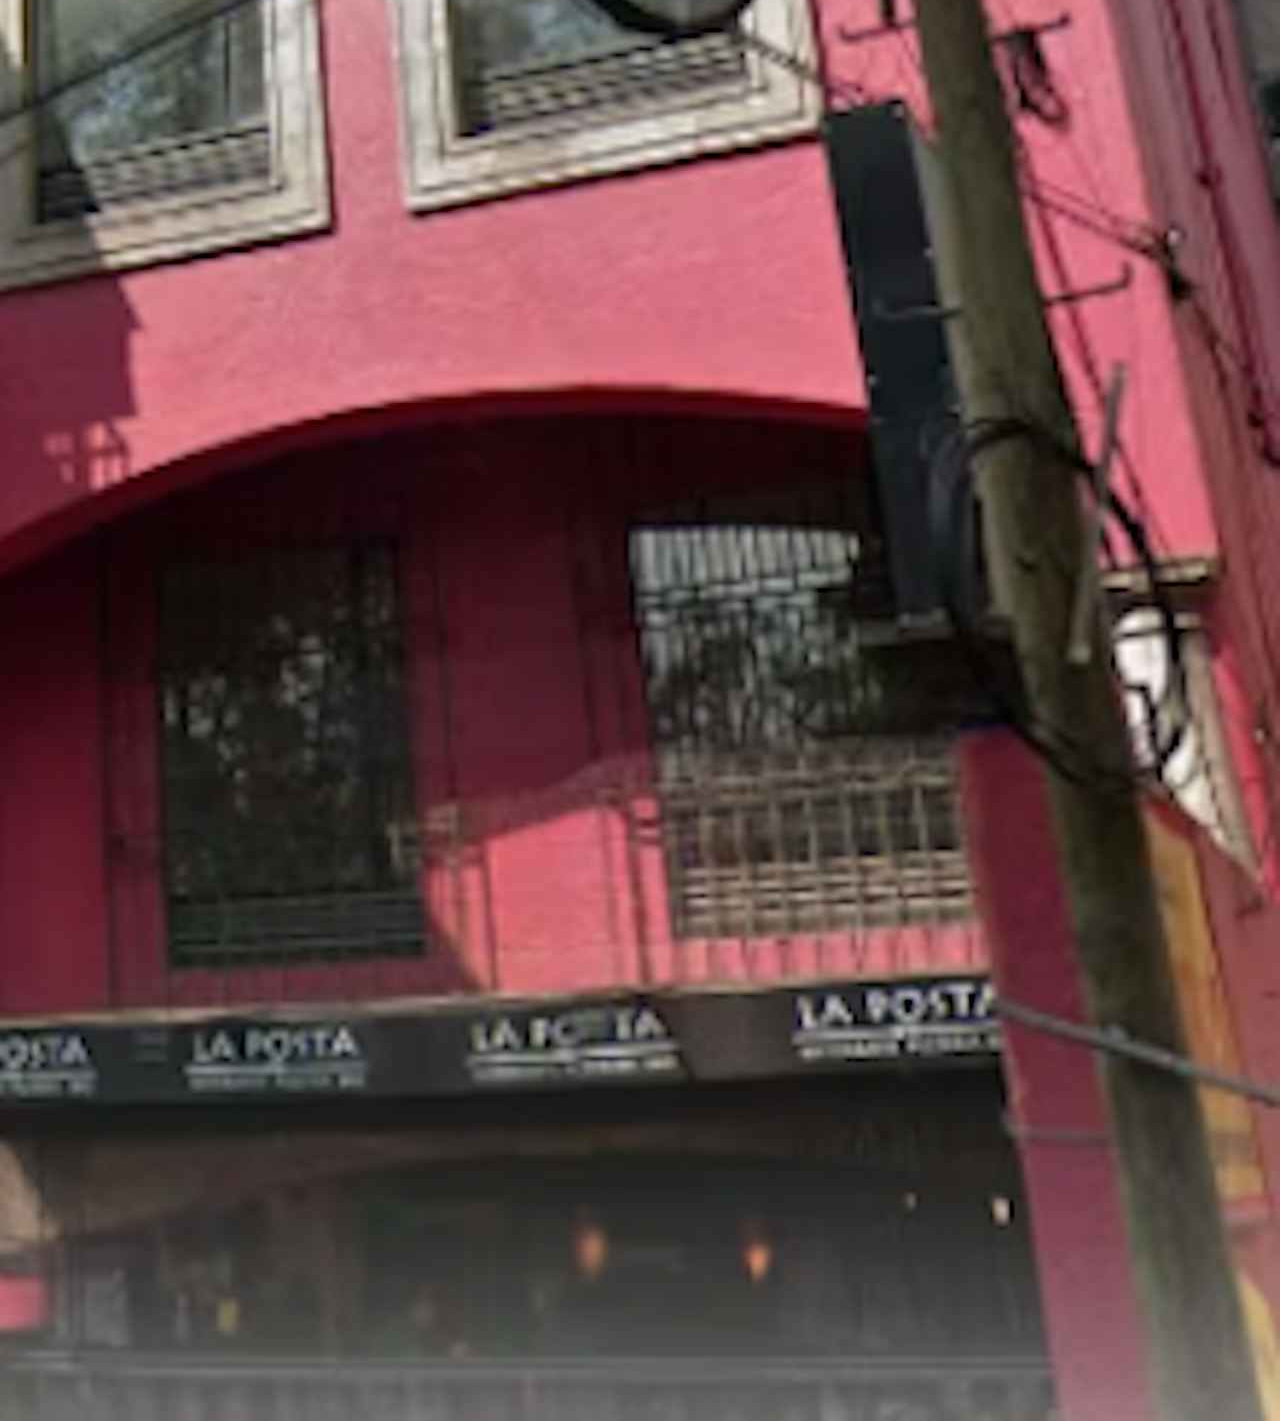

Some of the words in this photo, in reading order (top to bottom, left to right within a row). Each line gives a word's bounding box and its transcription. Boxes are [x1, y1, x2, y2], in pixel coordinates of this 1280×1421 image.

[797, 993, 855, 1030] LA
[192, 1029, 236, 1063] LA
[244, 1025, 360, 1062] POSTA
[472, 1016, 523, 1053] LA
